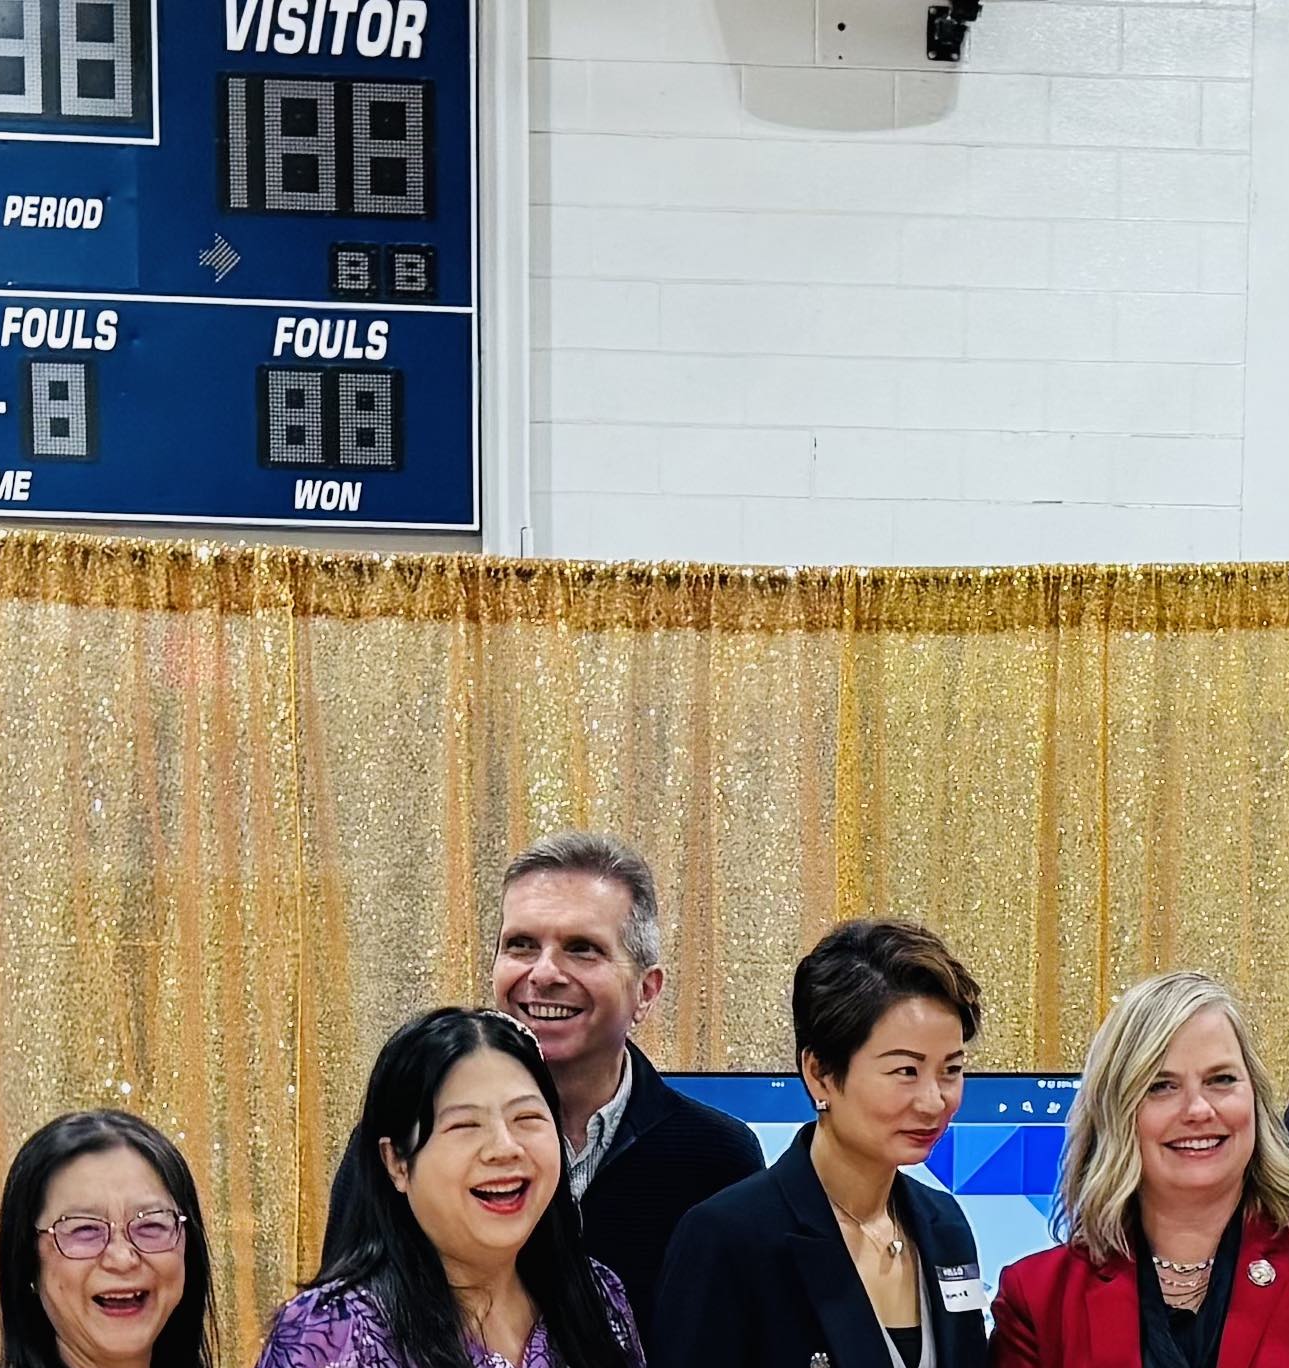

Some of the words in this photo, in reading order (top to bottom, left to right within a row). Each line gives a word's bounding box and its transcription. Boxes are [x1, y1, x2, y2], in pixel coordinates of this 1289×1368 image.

[225, 0, 428, 59] VISITOR
[3, 195, 103, 230] PERIOD
[0, 307, 119, 351] FOULS
[273, 317, 389, 361] FOULS
[294, 479, 362, 512] WON
